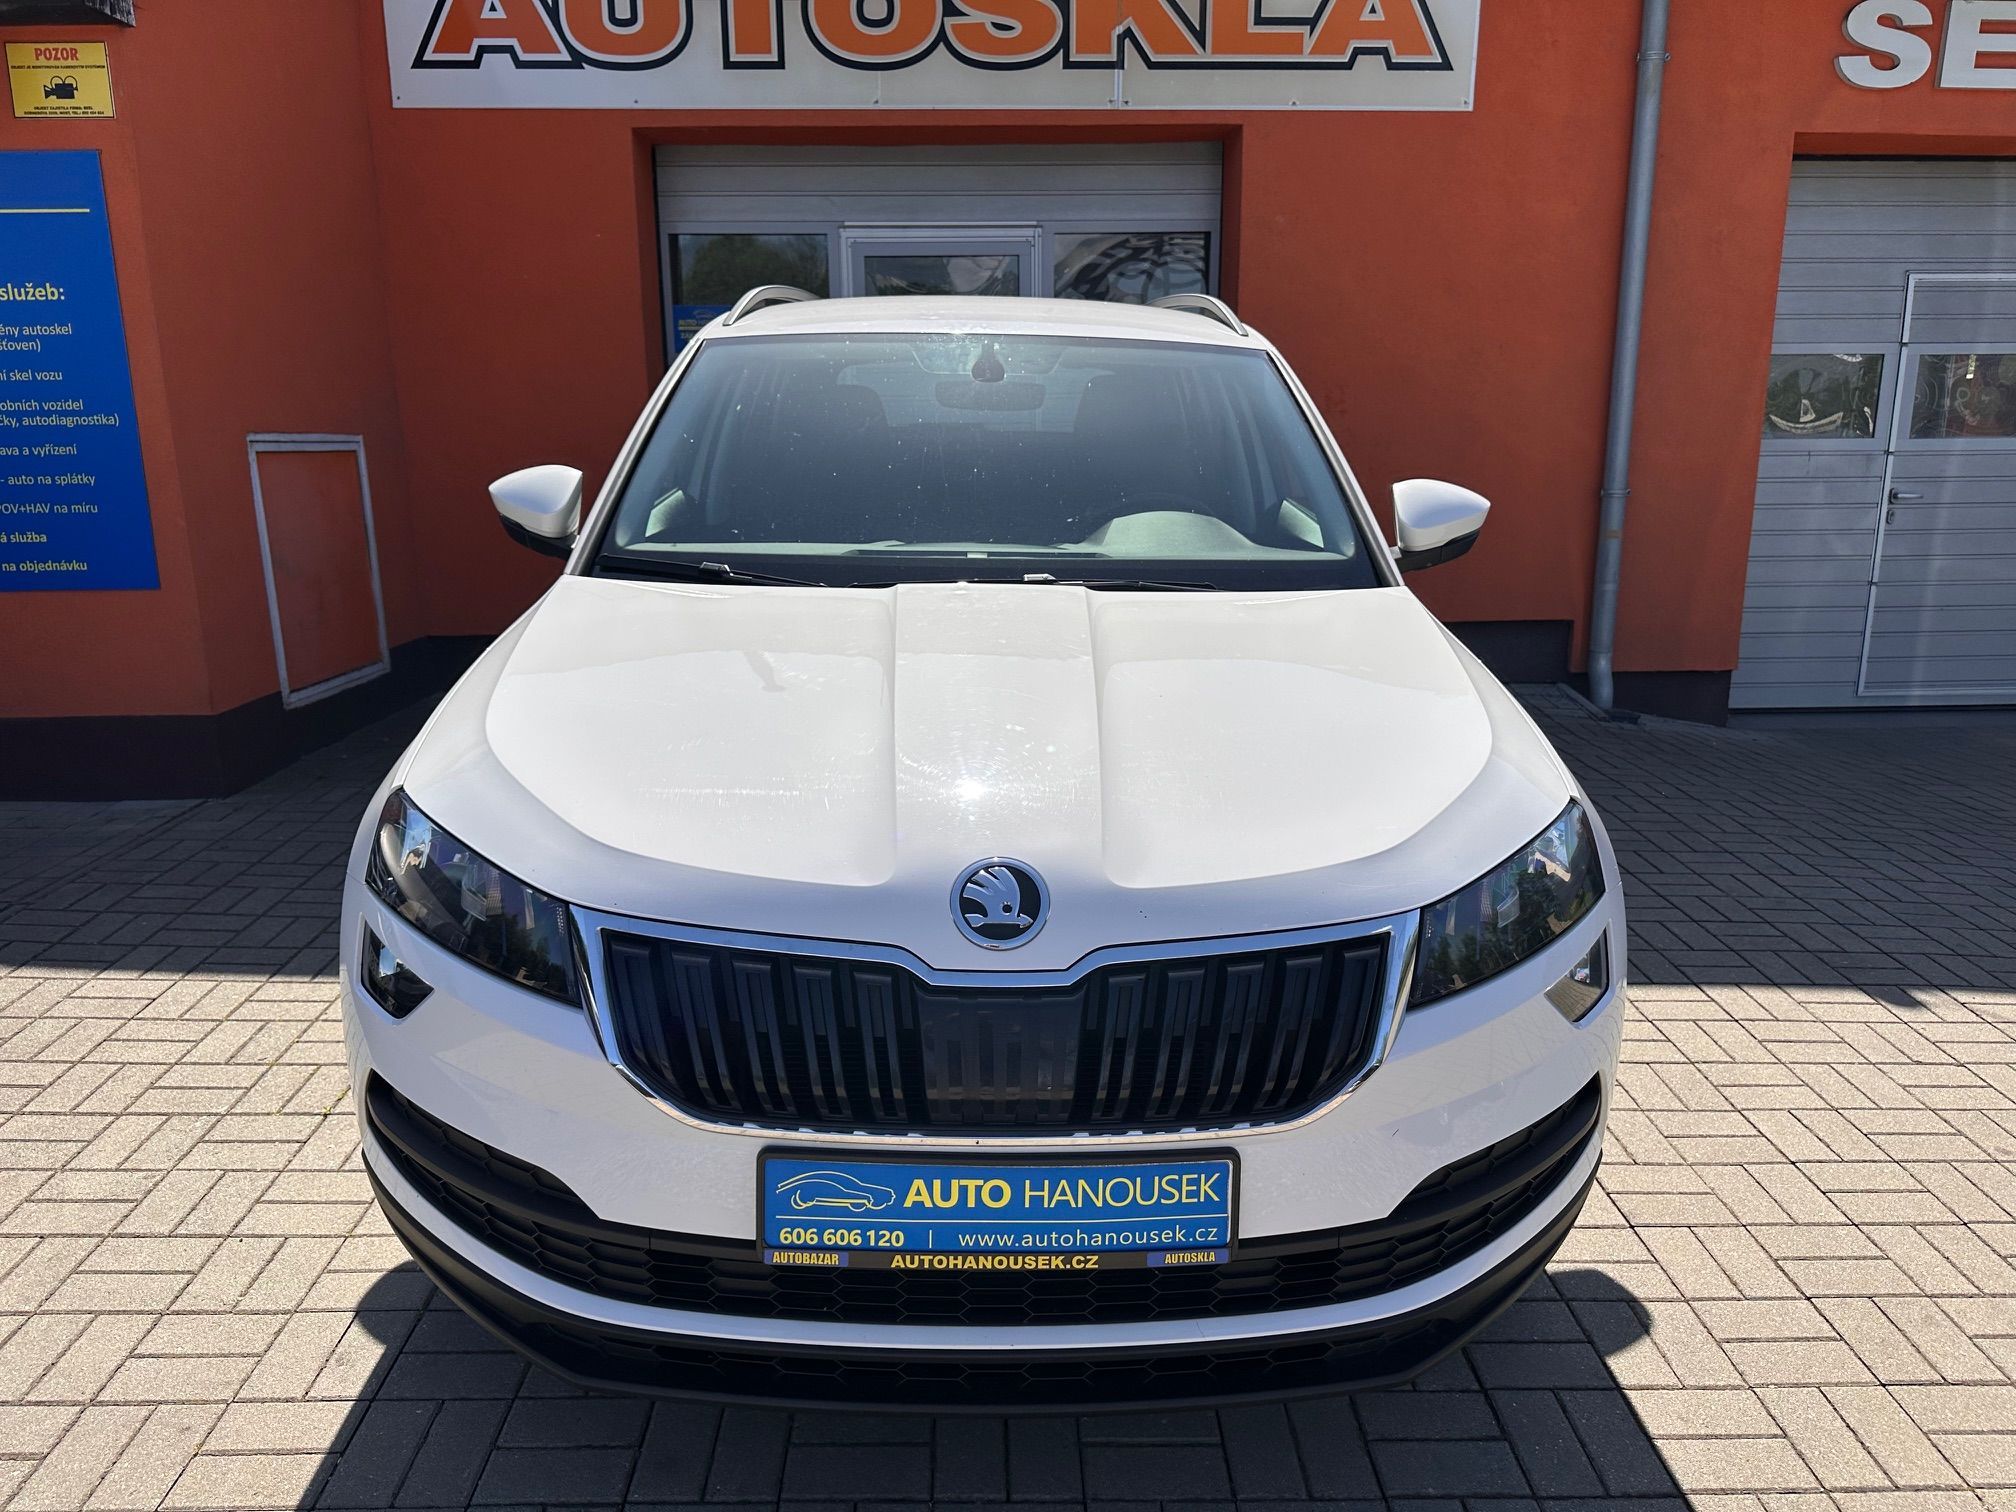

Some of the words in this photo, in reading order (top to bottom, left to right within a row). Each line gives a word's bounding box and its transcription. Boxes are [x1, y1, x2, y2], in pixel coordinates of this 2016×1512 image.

[34, 48, 79, 61] POZOR
[0, 283, 65, 301] služeb:
[22, 323, 72, 335] autoskel
[9, 369, 32, 381] skel
[35, 371, 63, 381] vozu
[0, 399, 40, 411] obních
[42, 399, 83, 411] vozidel
[22, 413, 119, 427] autodiagnostika)
[22, 446, 30, 456] a
[32, 443, 78, 457] vyřízení
[8, 475, 35, 485] auto
[37, 476, 52, 485] na
[55, 472, 96, 487] splátky
[0, 503, 51, 514] OV+HAV
[54, 505, 68, 514] na
[71, 501, 98, 514] míru
[10, 532, 47, 543] služba
[2, 563, 17, 572] na
[19, 560, 88, 573] objednávku
[903, 1178, 1012, 1208] AUTO
[1024, 1172, 1220, 1208] HANOUSEK
[779, 1227, 819, 1246] 606
[823, 1229, 863, 1247] 606
[866, 1229, 905, 1248] 120
[958, 1224, 1219, 1248] www.autohanousek.cz
[772, 1251, 840, 1266] AUTOBAZAR
[890, 1253, 1099, 1270] AUTOHANOUSEK.CZ
[1164, 1251, 1216, 1264] AUTOSKLA
